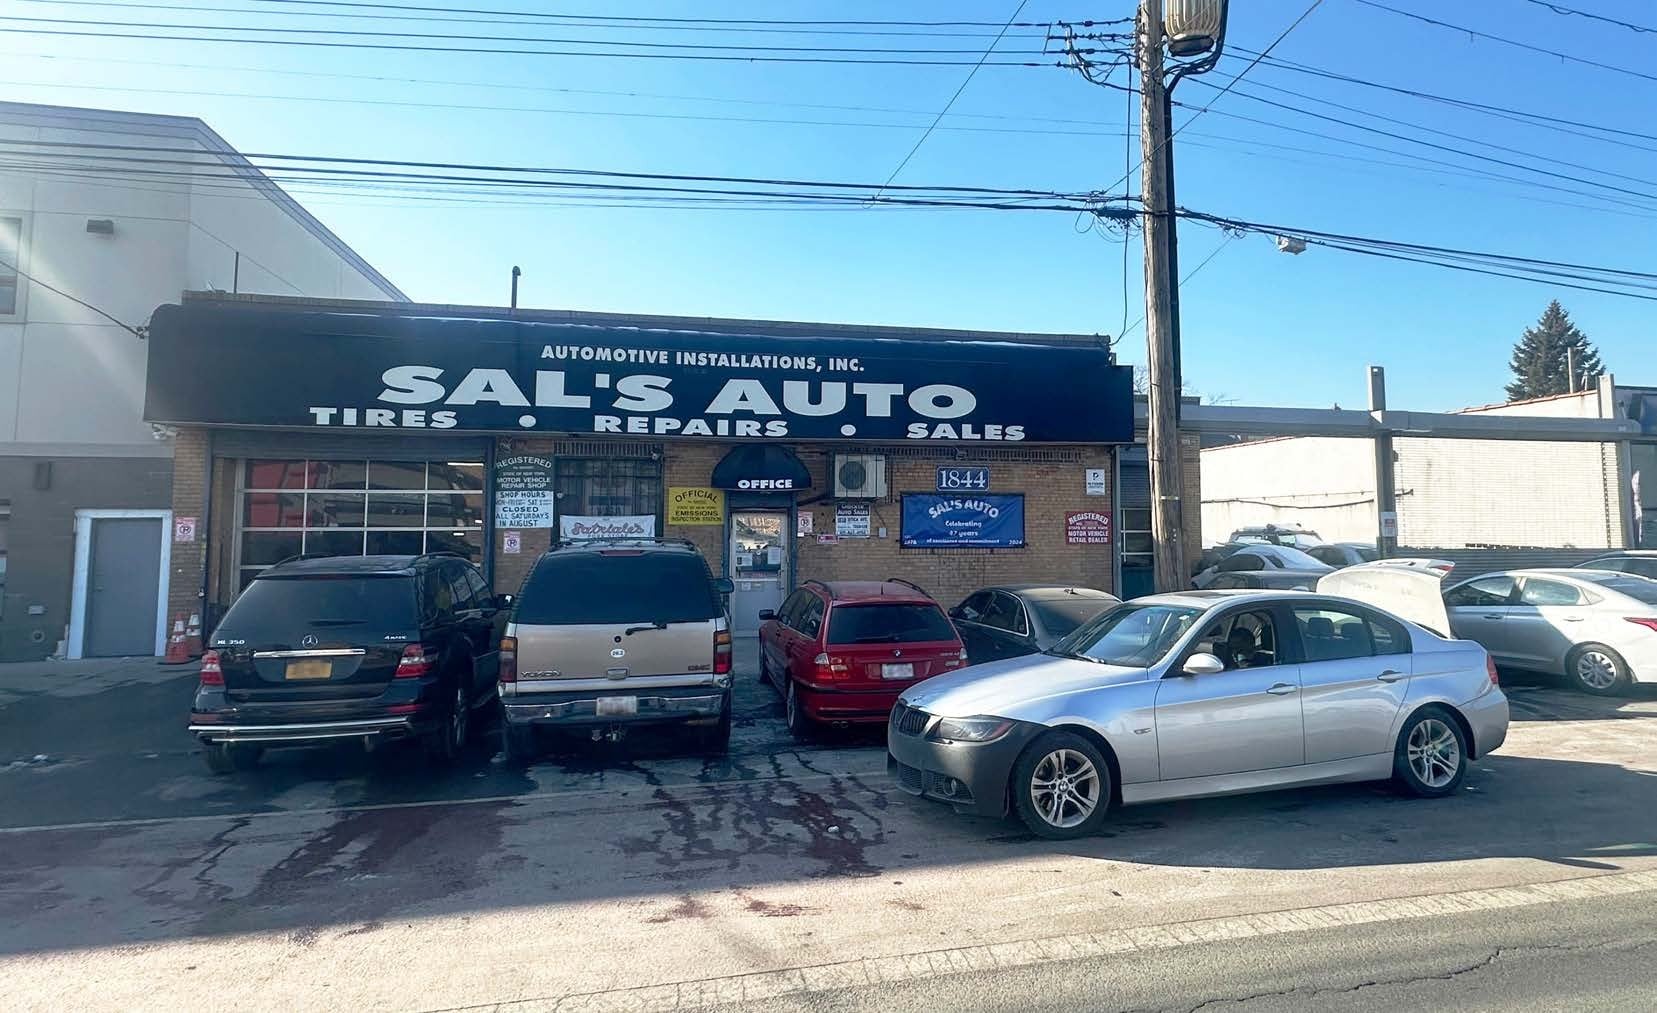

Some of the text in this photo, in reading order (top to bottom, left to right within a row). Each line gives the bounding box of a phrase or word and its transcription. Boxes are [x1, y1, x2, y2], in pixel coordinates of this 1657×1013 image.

[541, 345, 865, 373] AUTOMOTIVE INSTALLATIONS, INC.
[376, 365, 977, 419] SAL'S AUTO
[309, 406, 1026, 441] TIRES REPAIRS SALES
[496, 456, 552, 469] REGISTERED
[738, 479, 793, 489] OFFICE
[939, 470, 986, 488] 1844
[675, 490, 717, 504] OFFICIAL
[928, 500, 999, 519] SAL'S AUTO
[945, 520, 982, 528] Celebrating
[1068, 512, 1109, 525] REGISTERED
[958, 530, 979, 538] years
[520, 669, 561, 679] YUKON
